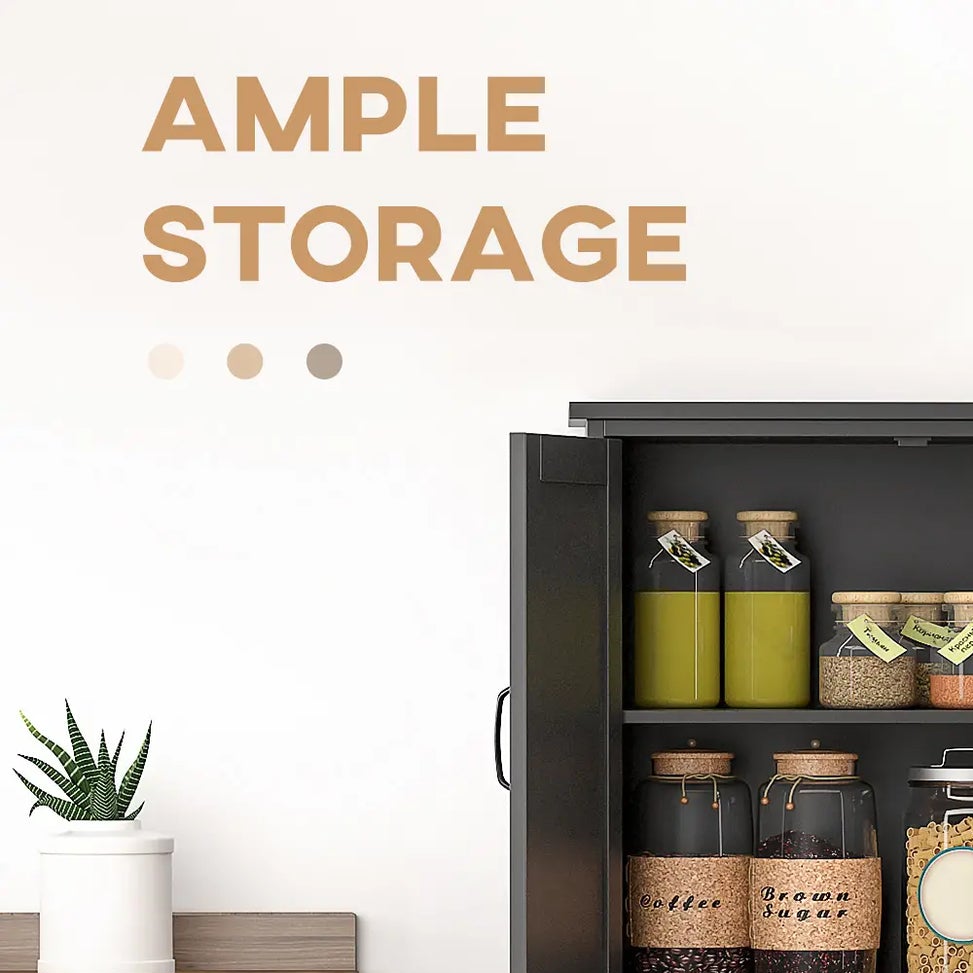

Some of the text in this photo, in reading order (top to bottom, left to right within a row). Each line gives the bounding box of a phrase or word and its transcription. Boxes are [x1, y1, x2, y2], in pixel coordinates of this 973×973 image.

[640, 894, 722, 911] Coffee
[760, 886, 850, 902] Brown
[762, 902, 849, 921] Sugar
